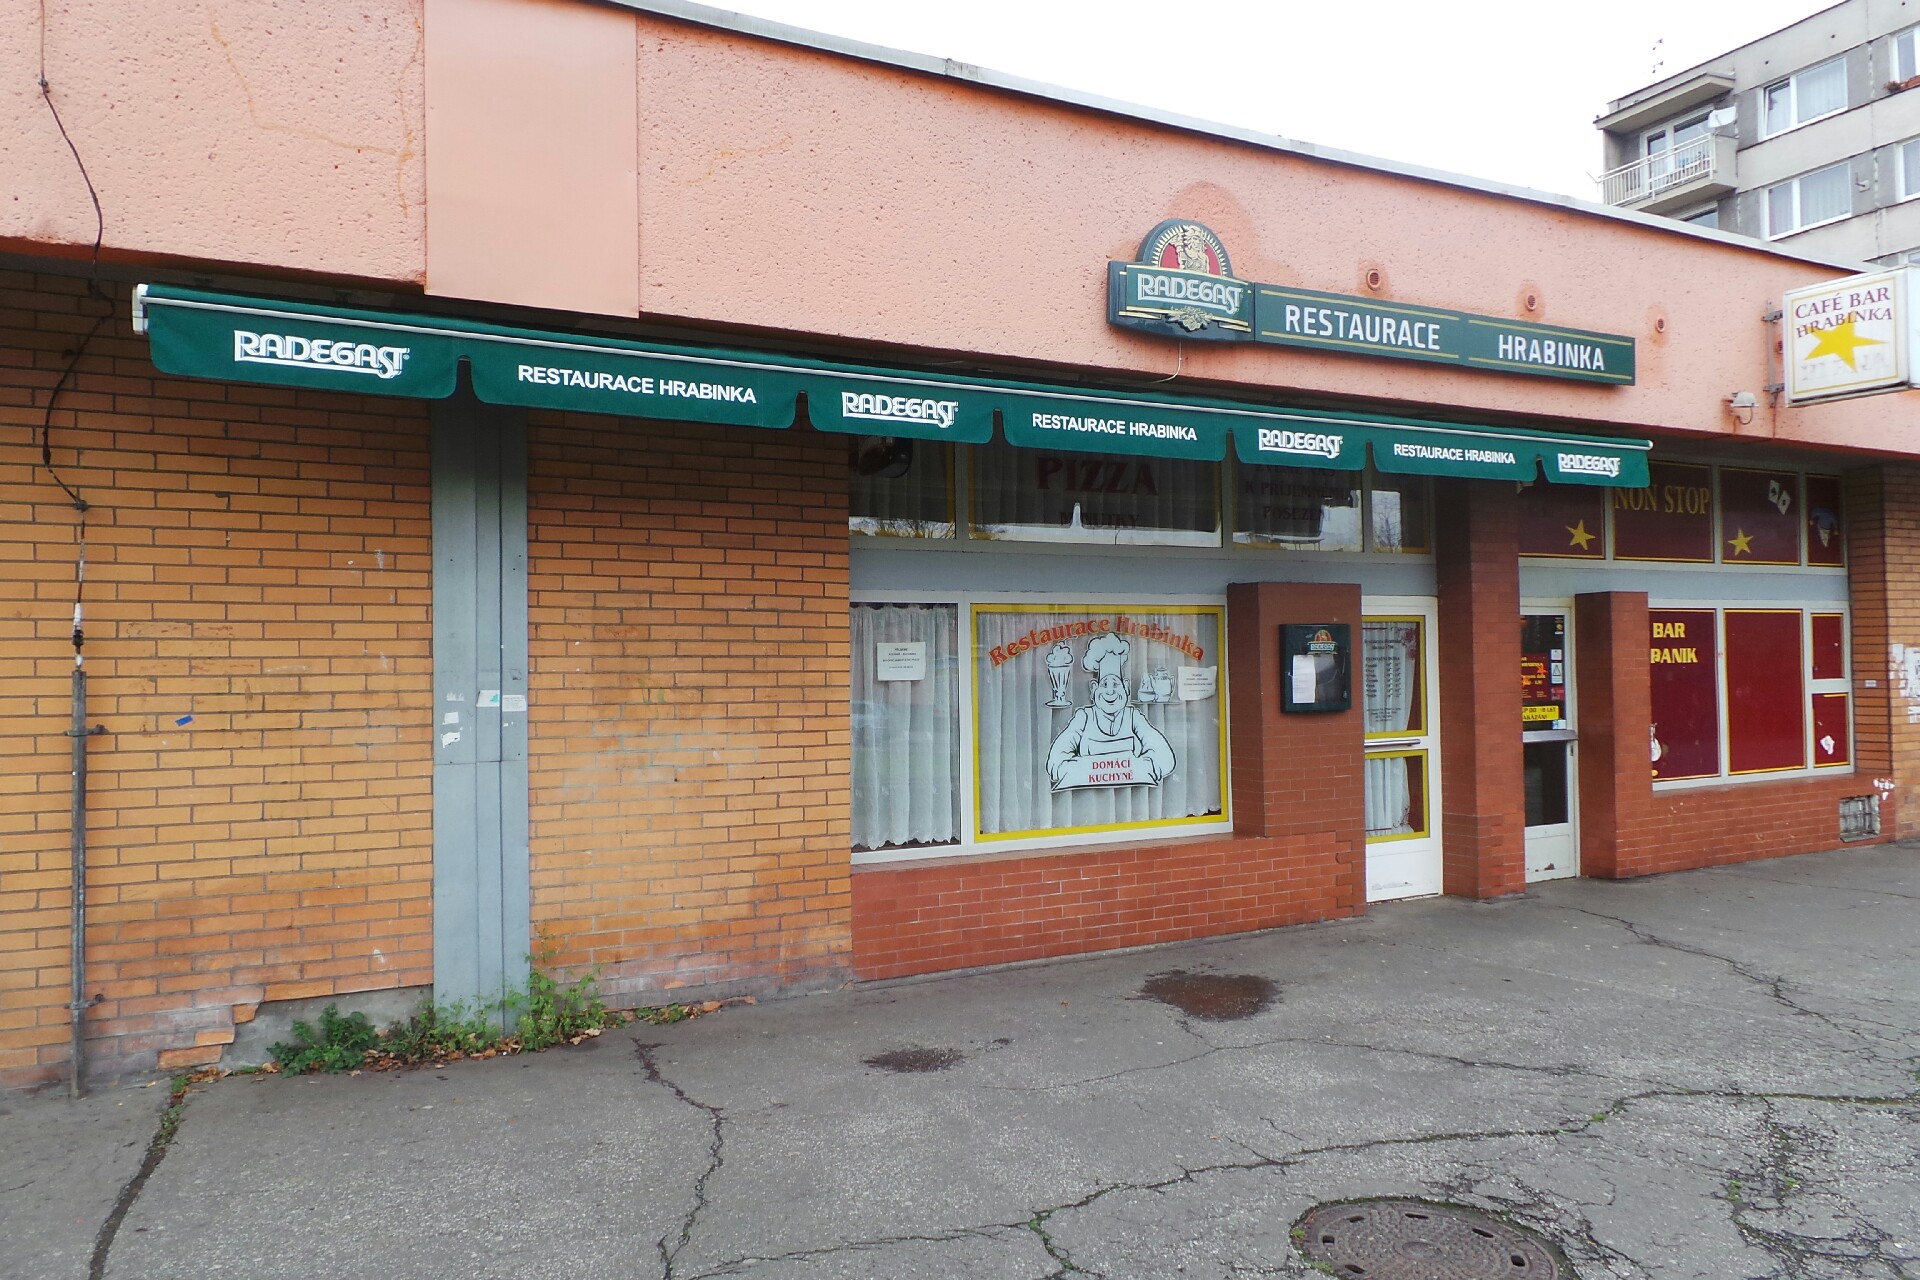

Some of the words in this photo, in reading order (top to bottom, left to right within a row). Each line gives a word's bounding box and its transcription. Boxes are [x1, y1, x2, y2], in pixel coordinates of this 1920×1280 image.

[1137, 273, 1243, 314] RADEGAST
[1795, 293, 1842, 319] CAFÉ
[1849, 287, 1891, 307] BAR
[1285, 304, 1441, 351] RESTAURACE
[1498, 333, 1605, 371] HRABINKA
[1796, 307, 1893, 338] HRABINKA
[234, 330, 409, 379] RADEGAST
[517, 364, 654, 394] RESTAURACE
[659, 379, 757, 404] HRABINKA
[841, 392, 958, 428] RADEGAST
[1032, 412, 1126, 435] RESTAURACE
[1129, 422, 1198, 441] HRABINKA
[1258, 428, 1343, 459] RADEGAST
[1393, 443, 1464, 461] RESTAURACE
[1464, 449, 1516, 464] HRABINKA
[1037, 457, 1158, 495] PIZZA
[1557, 453, 1621, 478] RADEGAST
[1614, 485, 1657, 511] NON
[1664, 485, 1710, 514] STOP
[988, 616, 1110, 668] Restaurace
[1115, 616, 1204, 662] Hrabinka
[1652, 622, 1686, 638] BAR
[1092, 757, 1131, 770] DOMÁCÍ
